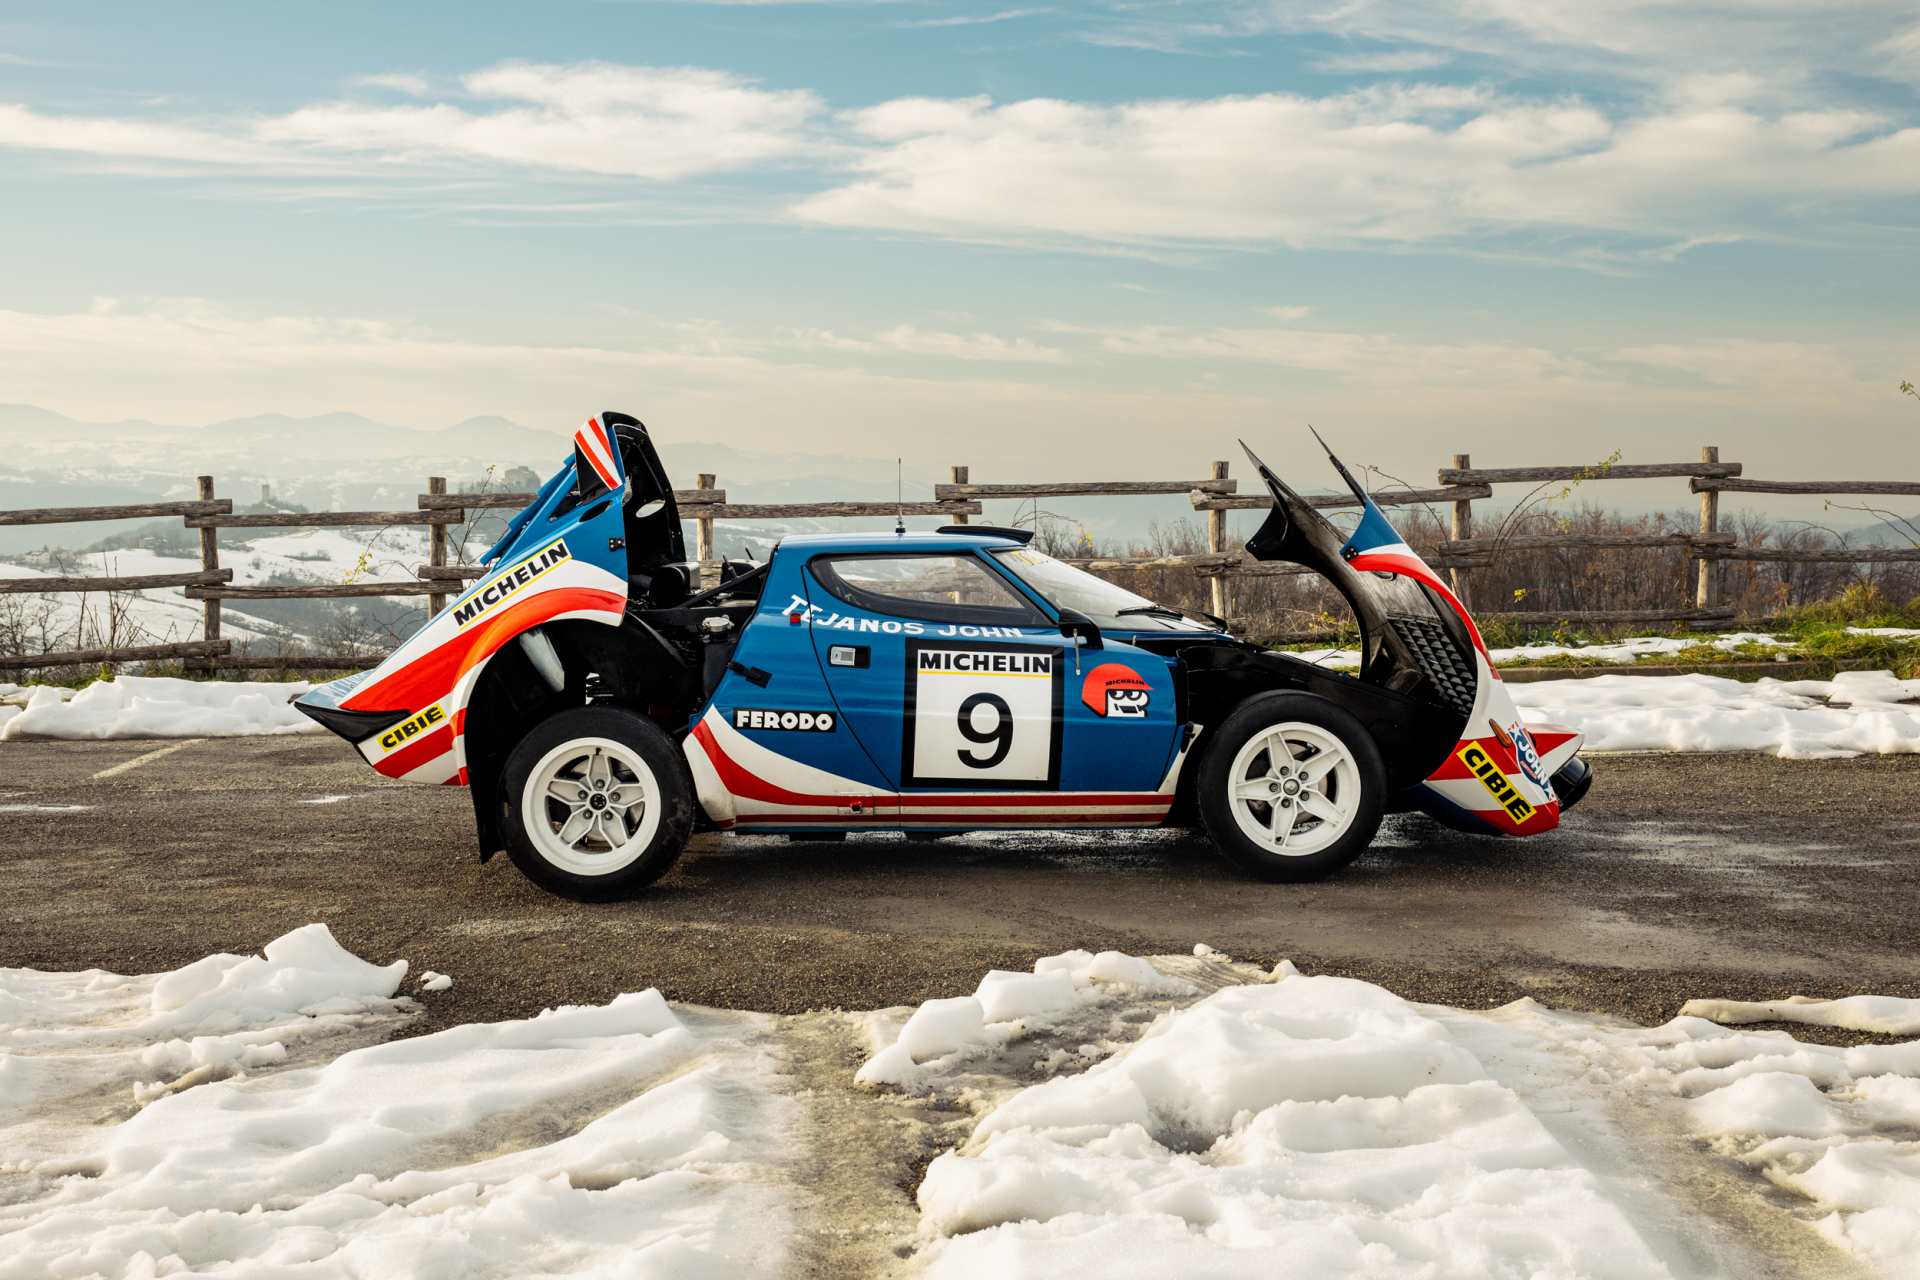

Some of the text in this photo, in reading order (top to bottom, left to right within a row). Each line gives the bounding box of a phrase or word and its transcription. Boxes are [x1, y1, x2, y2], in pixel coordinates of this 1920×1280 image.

[453, 542, 568, 626] MICHELIN
[781, 594, 1024, 639] TEJANOS JOHN
[919, 652, 1051, 673] MICHELIN
[382, 706, 443, 748] CIBIE
[736, 710, 833, 731] FERODO
[957, 692, 1014, 769] 9
[1464, 748, 1532, 821] CIBIE
